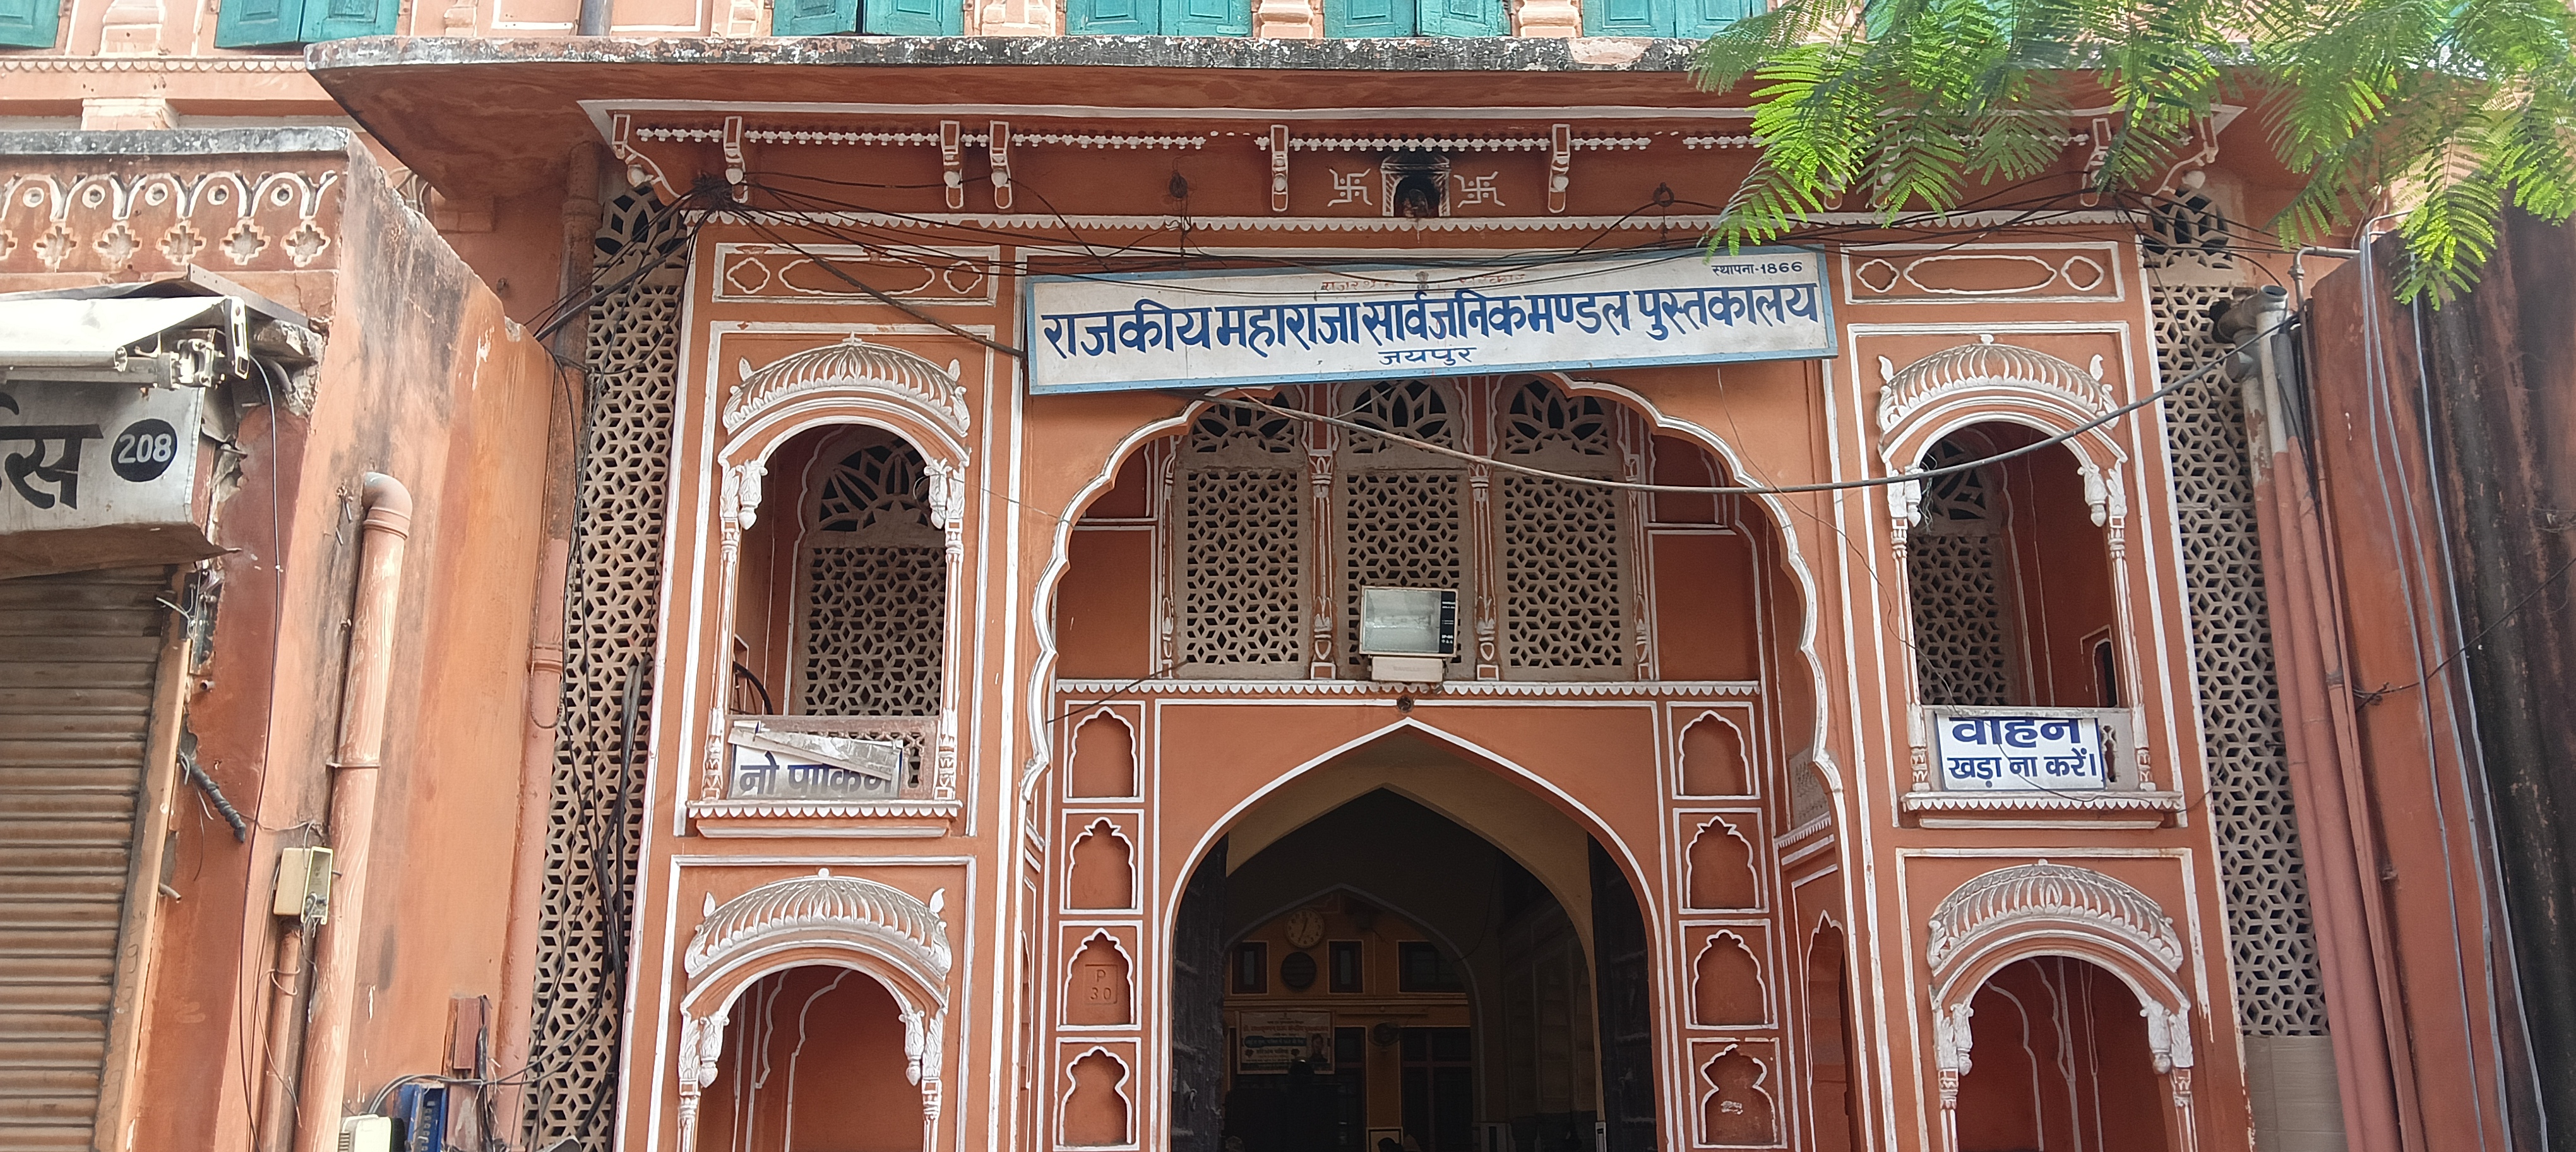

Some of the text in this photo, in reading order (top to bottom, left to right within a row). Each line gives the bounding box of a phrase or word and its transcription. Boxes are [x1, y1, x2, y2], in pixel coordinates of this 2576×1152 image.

[1712, 261, 1803, 277] स्थापना-1866
[1041, 282, 1818, 359] राजकीय महाराजा सार्वजनिक मण्डल पुस्तकालय
[1378, 347, 1477, 366] जयपुर
[118, 433, 172, 464] 208
[1948, 716, 2083, 748] वाहन
[739, 750, 780, 795] नो
[1947, 757, 2002, 788] खड़ा
[2008, 757, 2037, 777] ना
[1095, 969, 1106, 982] P
